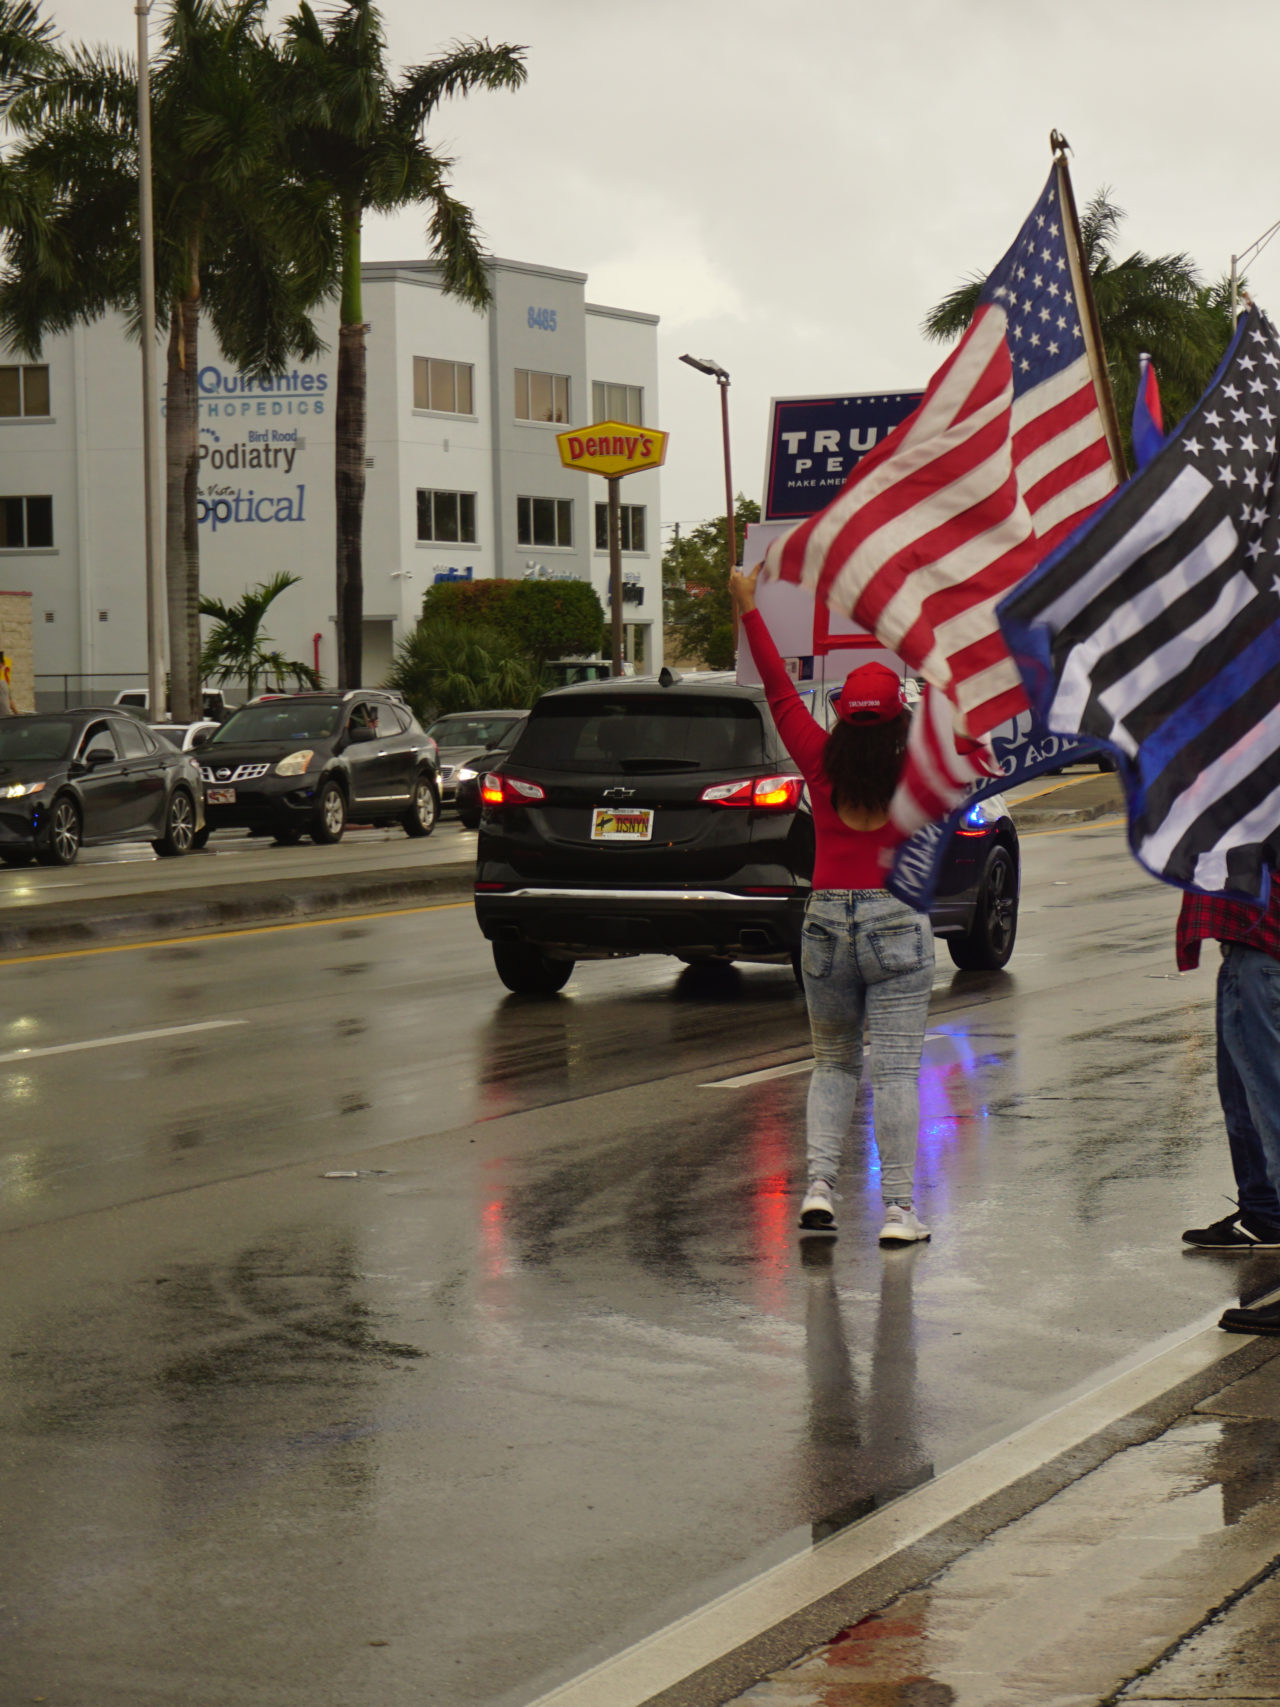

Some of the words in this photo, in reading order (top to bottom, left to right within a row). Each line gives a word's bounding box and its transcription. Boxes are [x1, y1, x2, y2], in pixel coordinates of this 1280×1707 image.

[527, 305, 557, 332] 8485
[197, 366, 328, 394] Quirantes
[160, 400, 325, 418] OHOPEDICS
[248, 429, 269, 443] Bird
[271, 428, 298, 442] Road
[567, 433, 654, 461] Denny's
[781, 425, 899, 455] TRU
[198, 442, 297, 474] Podiatry
[787, 478, 817, 488] MAKE
[819, 477, 848, 487] AMER
[197, 484, 306, 532] optical
